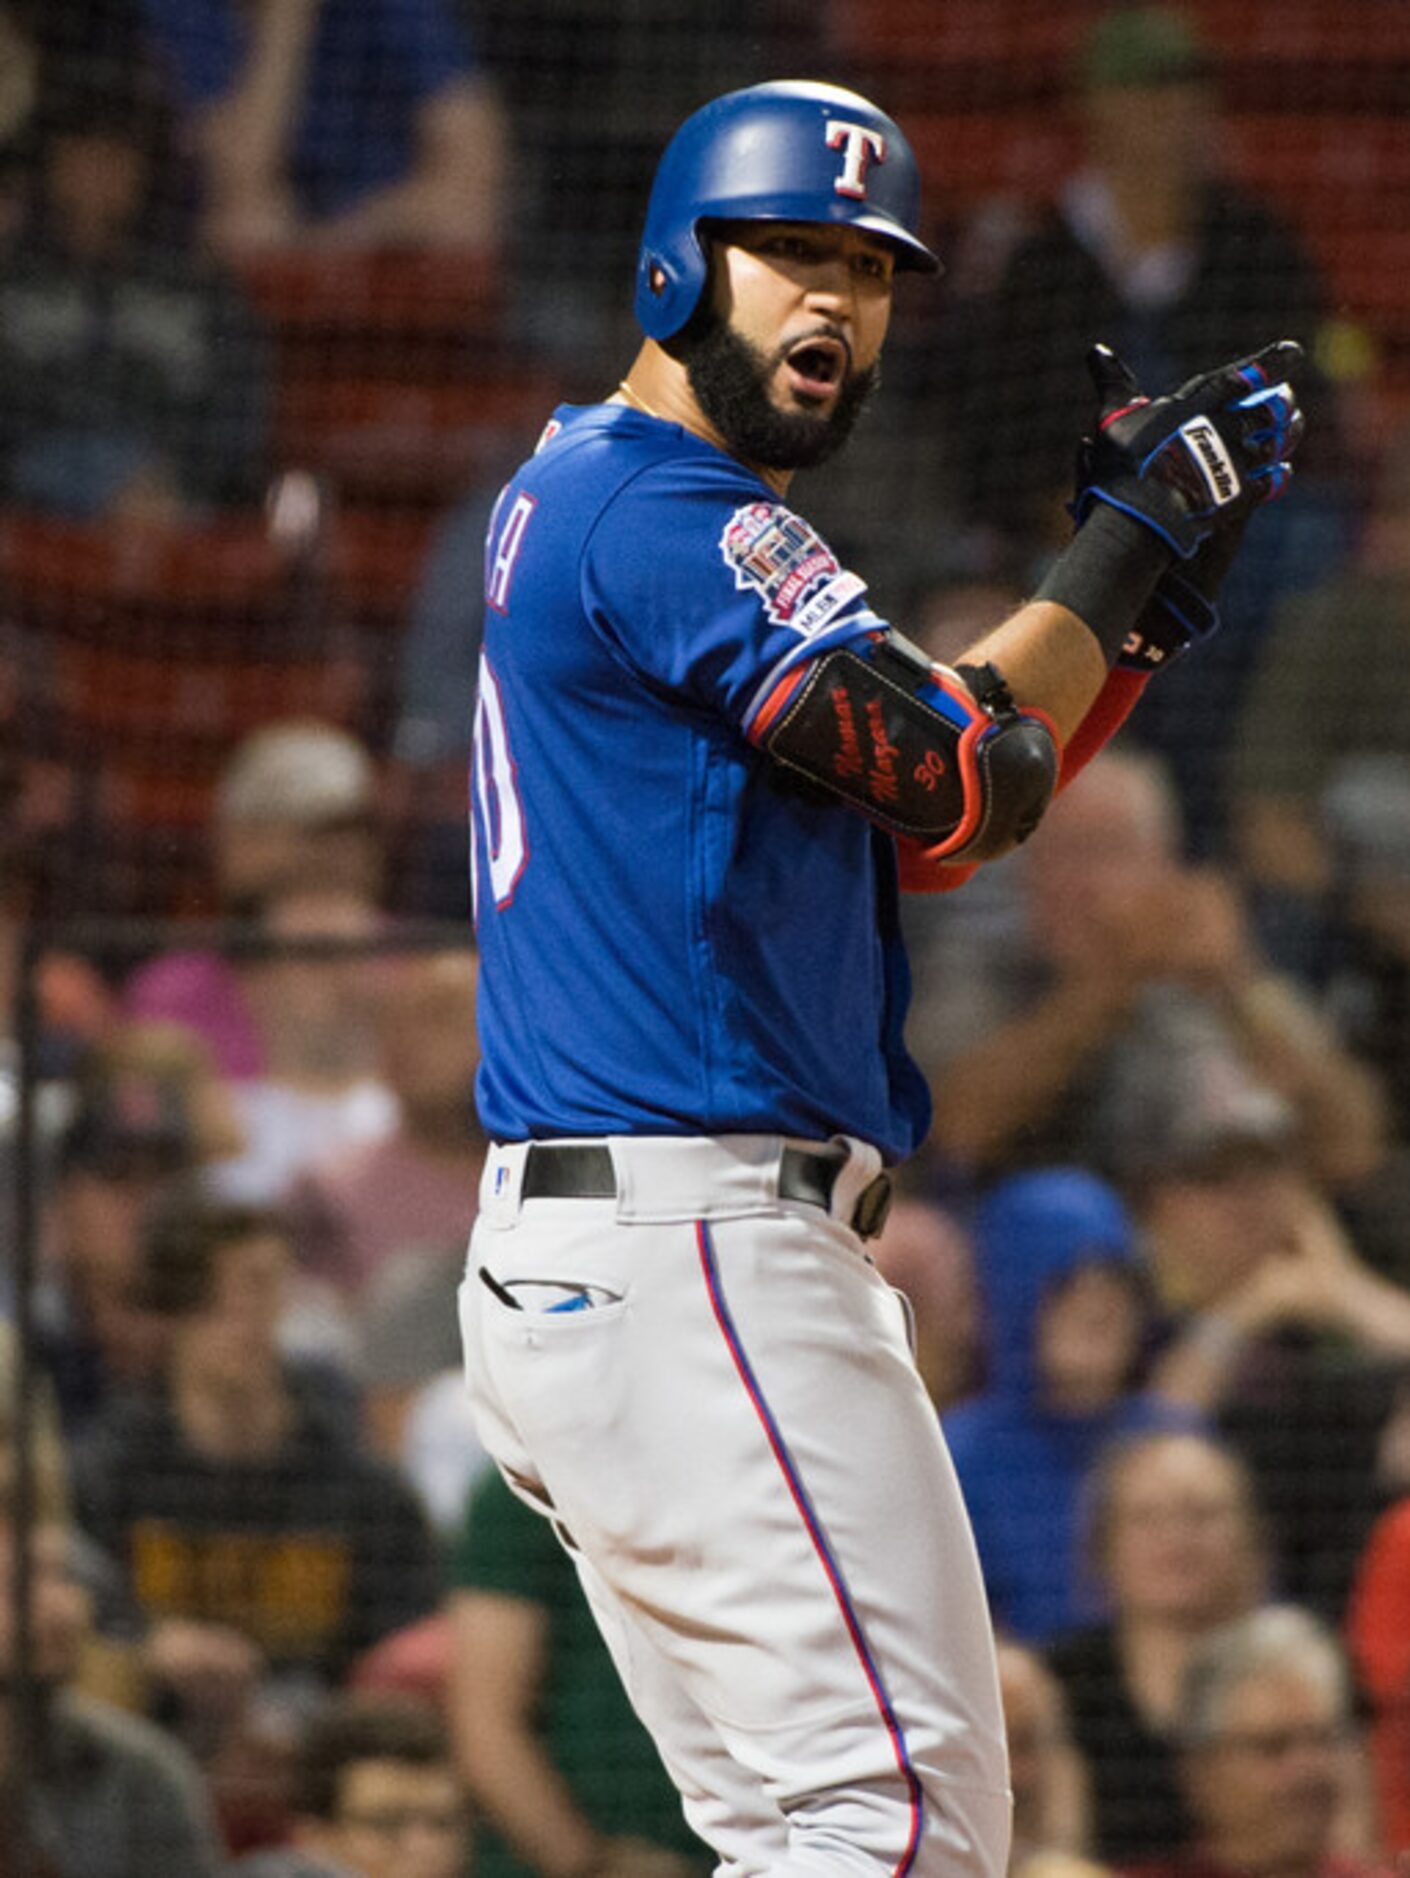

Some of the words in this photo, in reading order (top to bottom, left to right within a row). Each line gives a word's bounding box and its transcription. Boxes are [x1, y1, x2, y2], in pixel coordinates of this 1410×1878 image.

[825, 120, 887, 200] T
[1187, 425, 1232, 499] Franklin
[913, 750, 945, 792] 30
